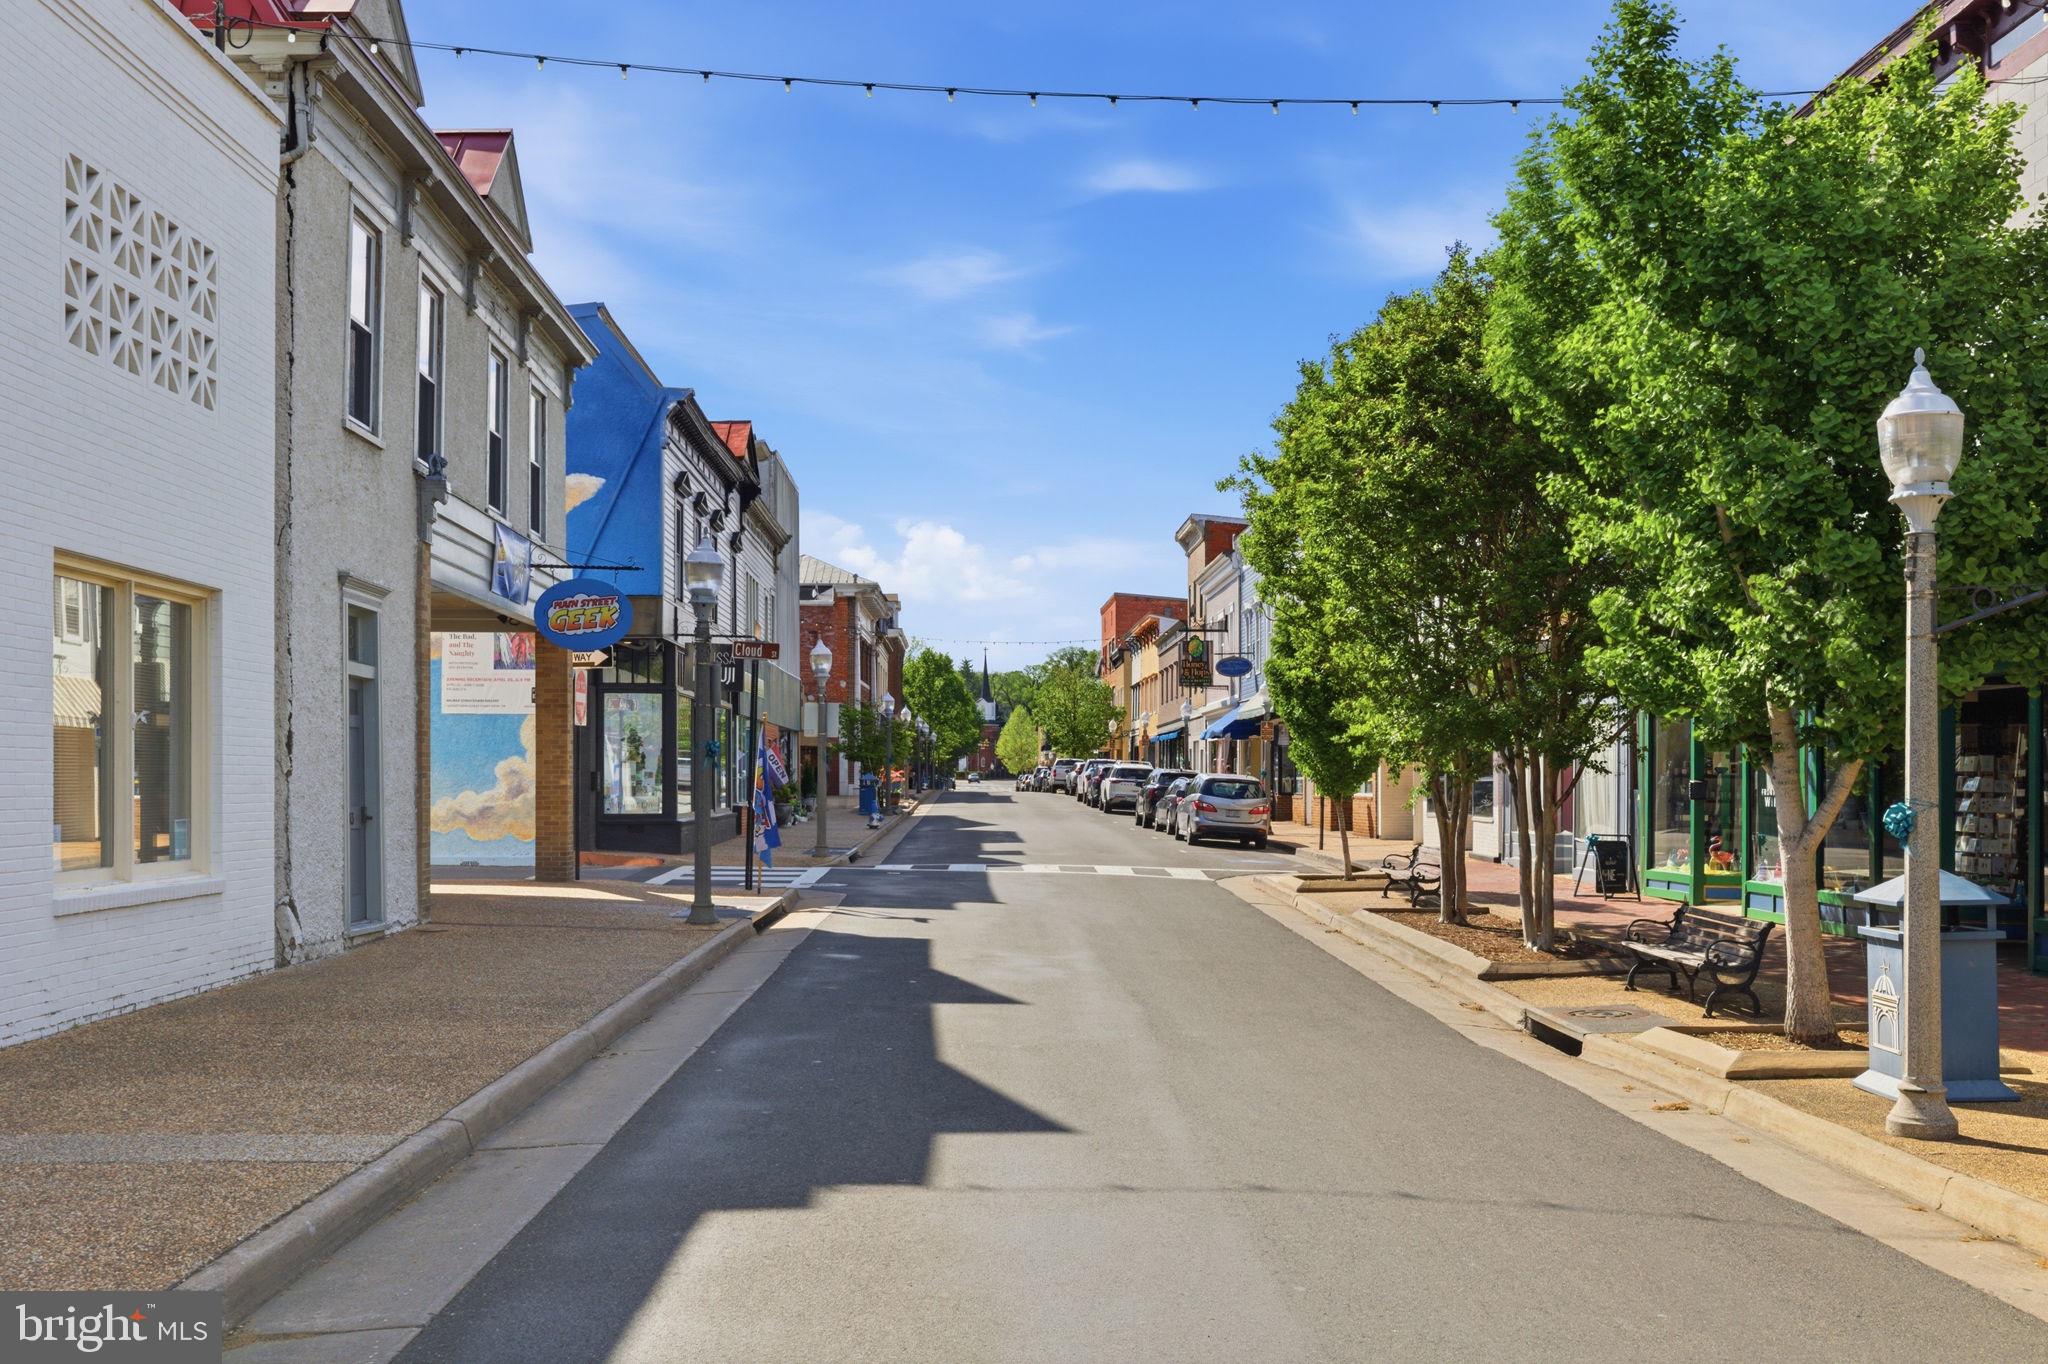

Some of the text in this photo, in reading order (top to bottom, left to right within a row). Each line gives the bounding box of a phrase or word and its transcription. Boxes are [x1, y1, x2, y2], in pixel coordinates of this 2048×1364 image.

[554, 597, 617, 609] MAIN STREET
[549, 607, 618, 632] GEEK
[573, 653, 592, 661] WAY
[735, 643, 763, 657] Cloud
[768, 754, 787, 780] OPEN
